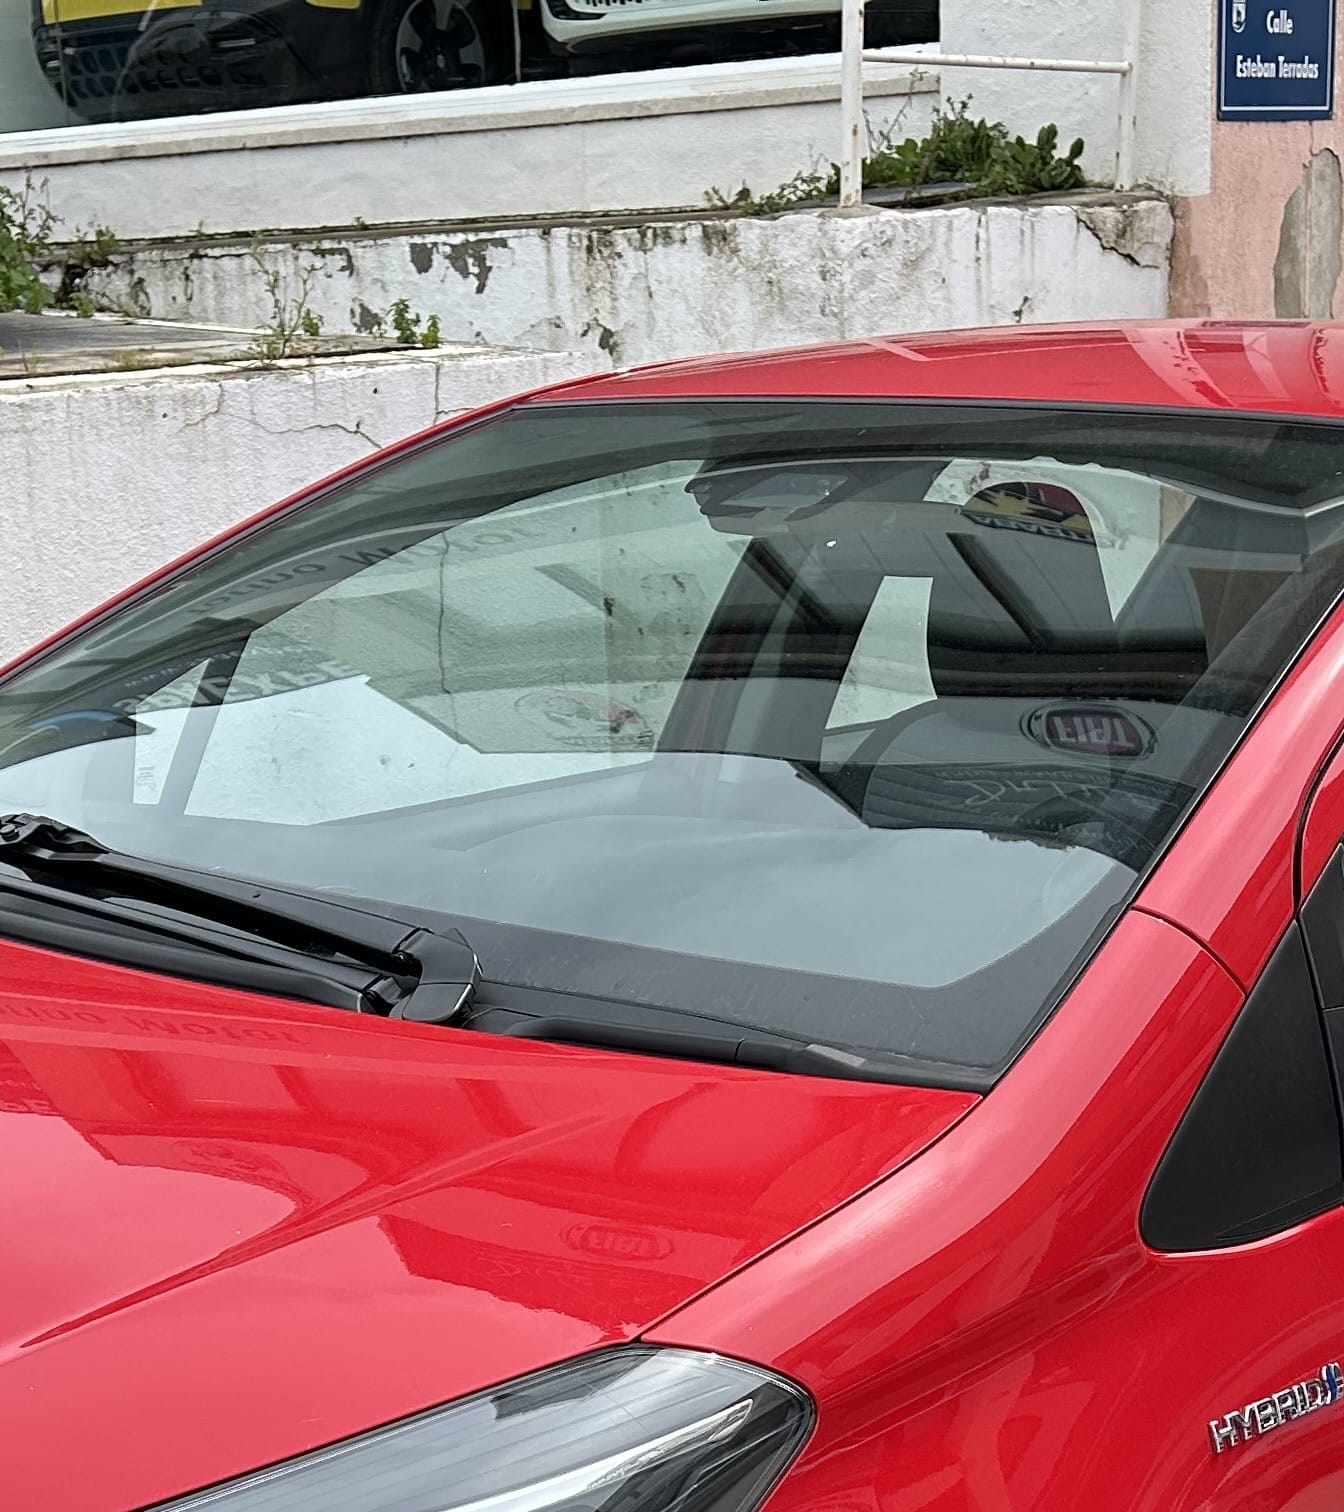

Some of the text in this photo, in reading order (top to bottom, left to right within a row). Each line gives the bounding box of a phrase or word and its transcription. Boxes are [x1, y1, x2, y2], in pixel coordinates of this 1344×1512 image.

[1266, 9, 1294, 34] Calle
[1236, 54, 1319, 80] Esteban Terradas
[1209, 1377, 1331, 1454] HYBRID
